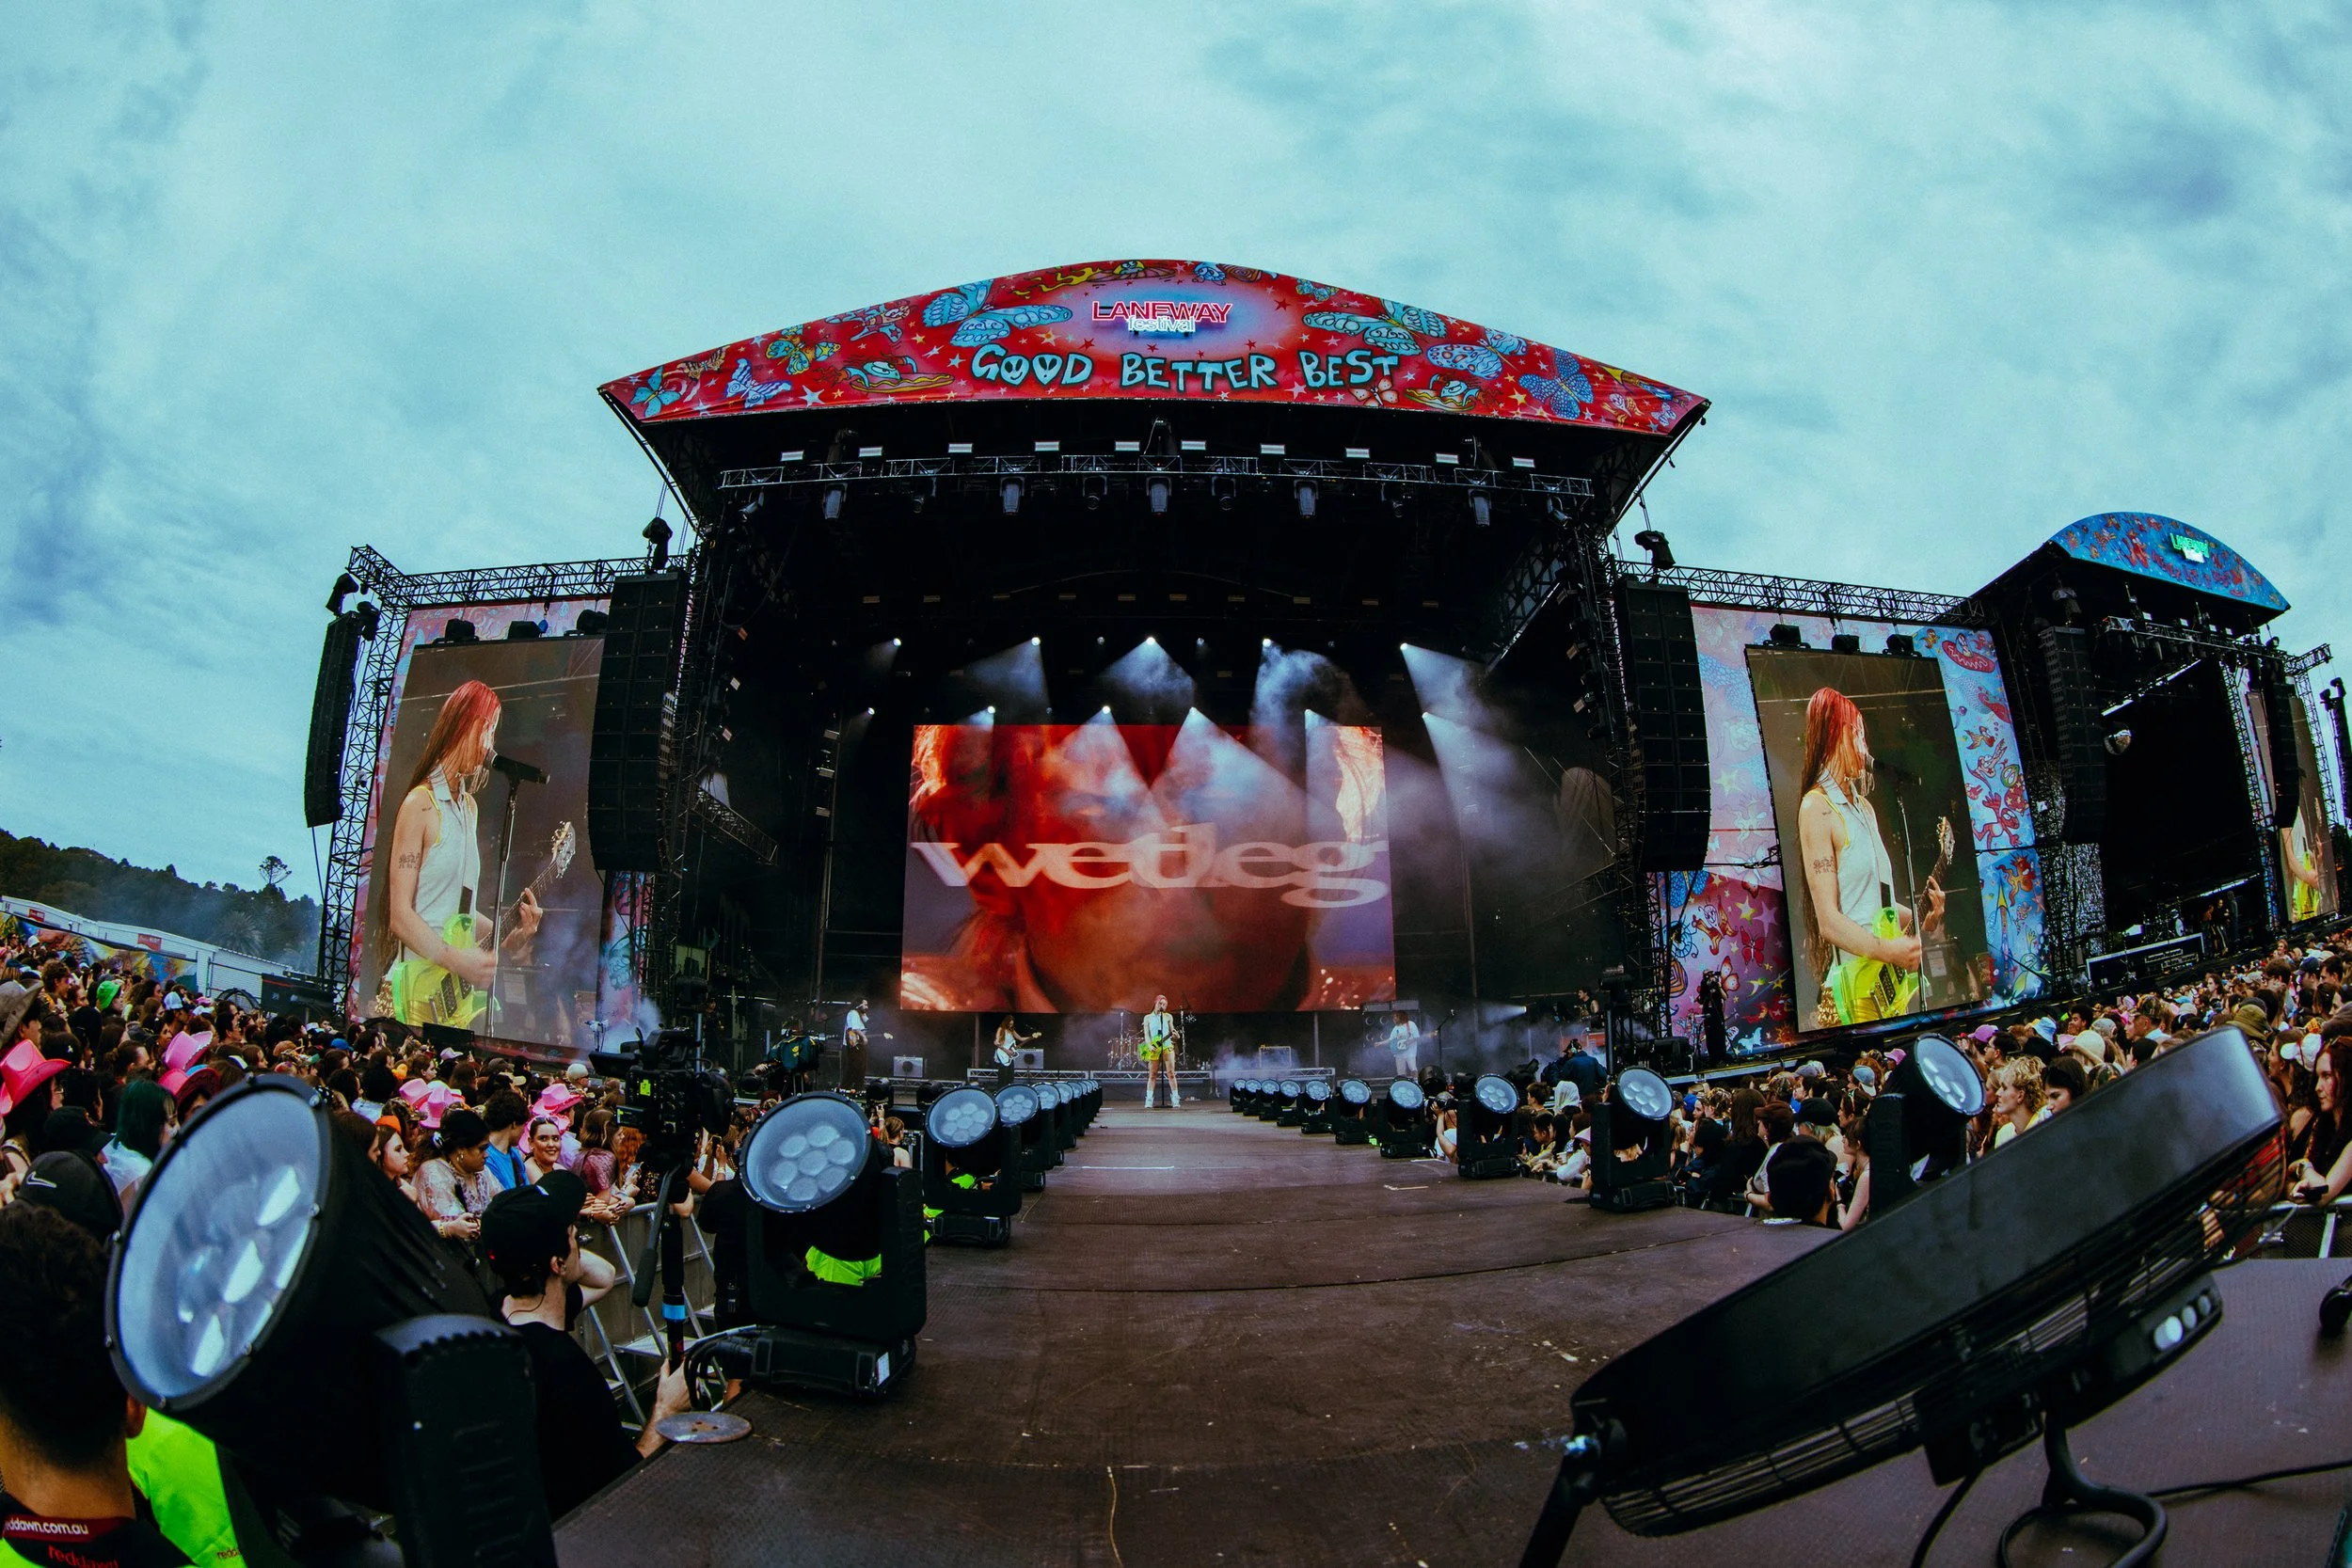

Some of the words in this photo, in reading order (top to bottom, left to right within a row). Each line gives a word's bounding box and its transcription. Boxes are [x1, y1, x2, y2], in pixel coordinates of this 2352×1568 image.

[1091, 300, 1232, 323] LANEWAY
[1126, 314, 1196, 332] festival
[971, 343, 1093, 388] GOOD
[1120, 353, 1278, 391] BETTER
[1299, 349, 1401, 388] BEST
